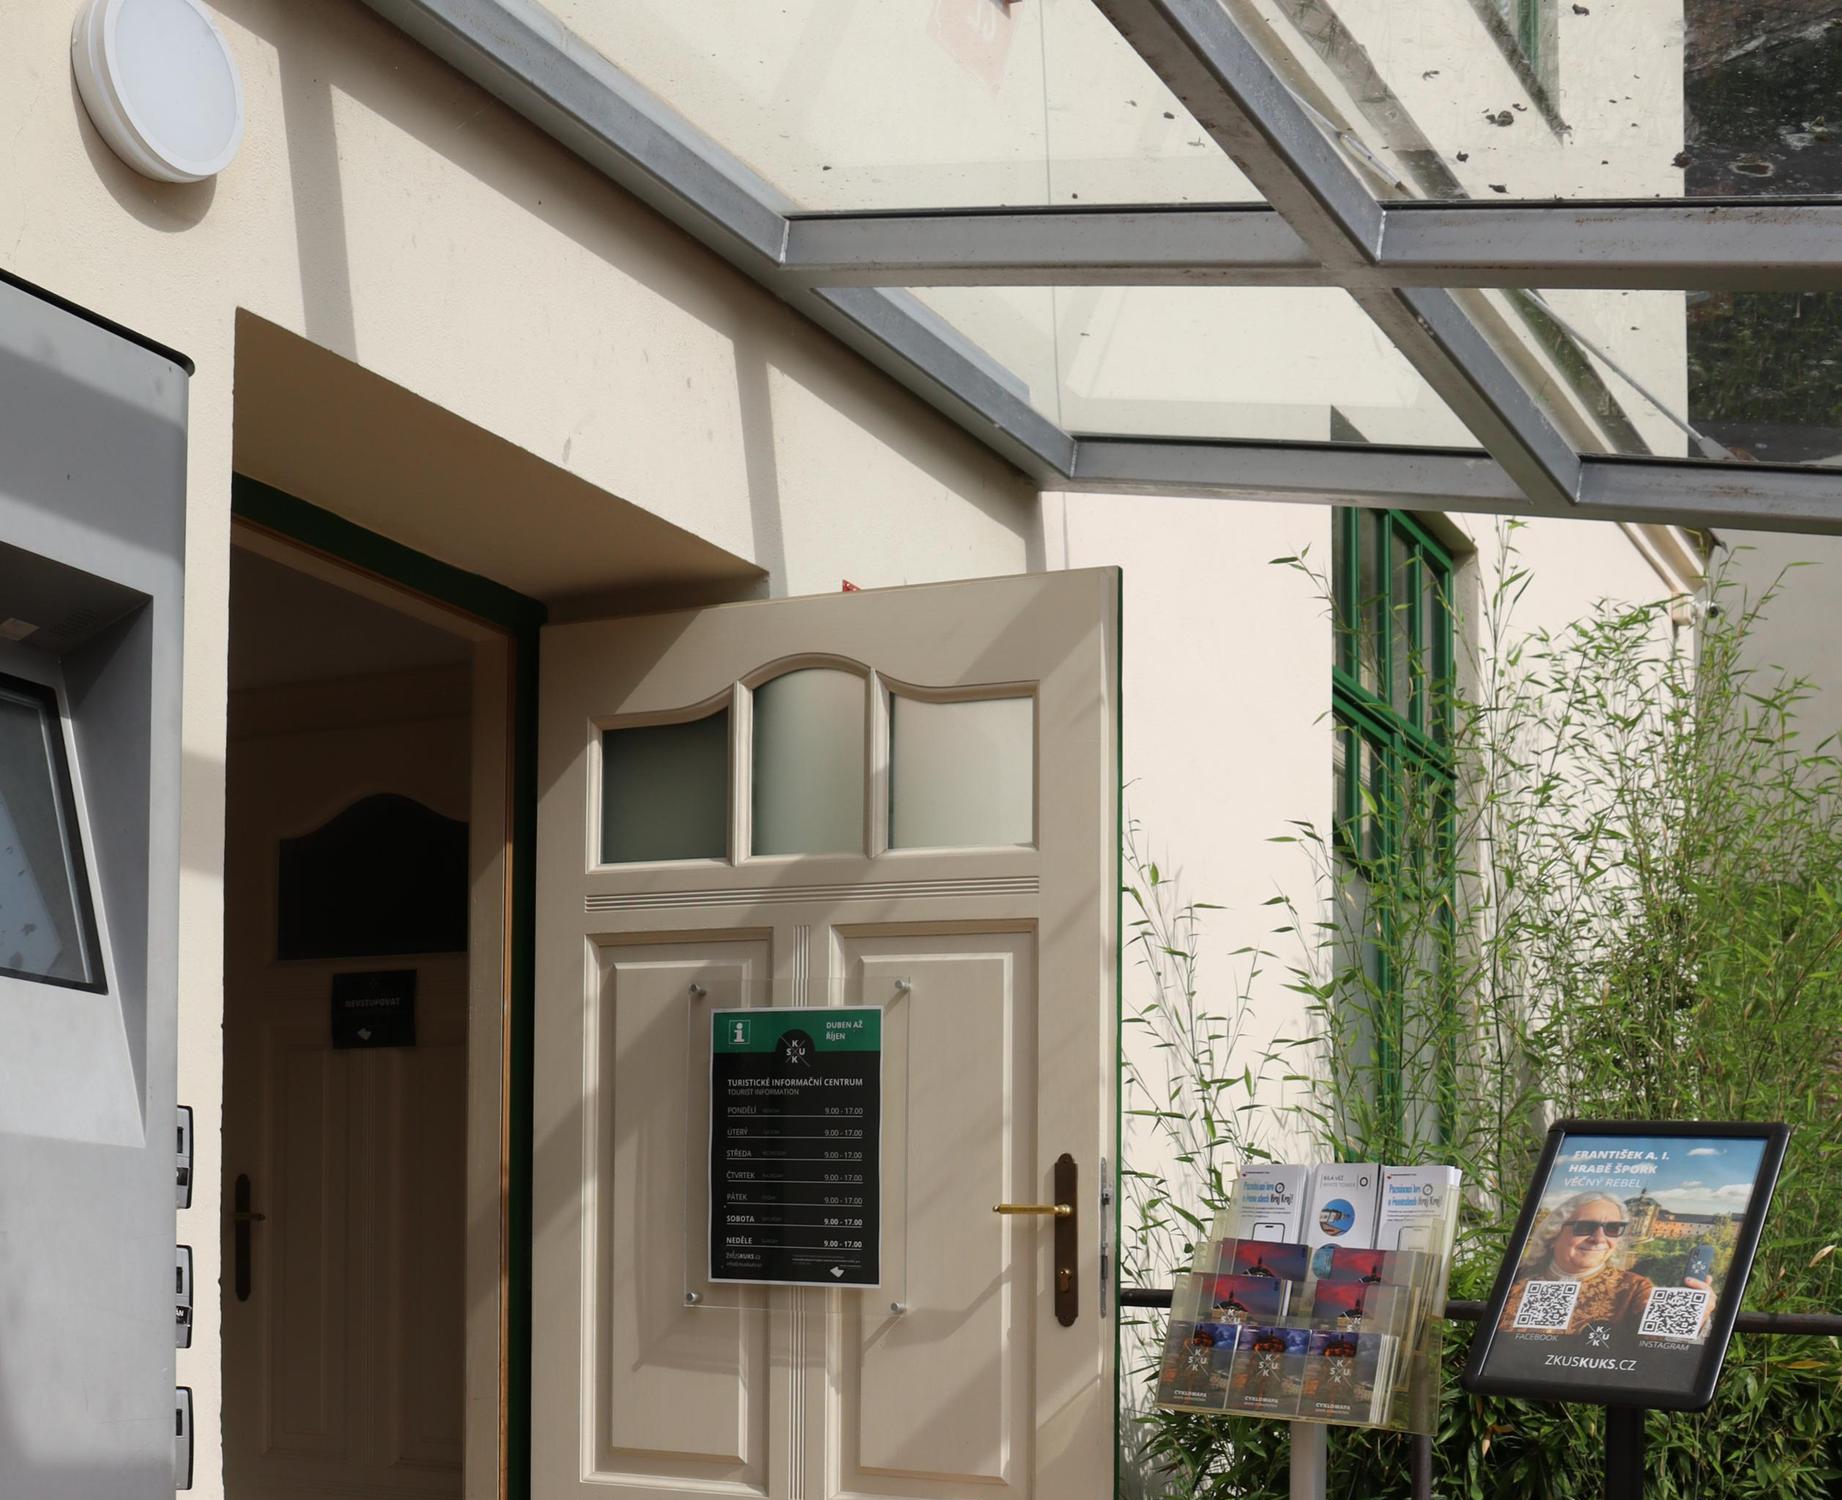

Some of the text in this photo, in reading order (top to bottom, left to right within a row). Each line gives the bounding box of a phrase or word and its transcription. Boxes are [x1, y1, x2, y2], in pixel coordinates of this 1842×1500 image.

[826, 1019, 864, 1029] DUBEN AŽ
[727, 1076, 864, 1087] TURISTICKÉ INFORMAČNÍ CENTRUM
[727, 1088, 799, 1096] TOURIST INFORMATION
[824, 1107, 839, 1115] 9.00
[844, 1107, 864, 1115] 17.00
[824, 1129, 839, 1137] 9.00
[844, 1129, 863, 1137] 17.00
[824, 1151, 839, 1160] 9.00
[844, 1151, 863, 1160] 17.00
[1574, 1148, 1644, 1160] FRANTIŠEK
[1644, 1151, 1658, 1160] A.
[1568, 1162, 1658, 1174] HRABĚ ŠPORK
[824, 1174, 839, 1182] 9.00
[844, 1174, 863, 1182] 17.00
[1605, 1178, 1642, 1188] REBEL
[824, 1196, 839, 1205] 9.00
[844, 1196, 863, 1205] 17.00
[726, 1215, 755, 1223] SOBOTA
[823, 1218, 839, 1227] 9.00
[844, 1218, 863, 1227] 17.00
[726, 1234, 753, 1245] NEDĚLE
[823, 1240, 839, 1248] 9.00
[844, 1240, 863, 1248] 17.00
[1514, 1333, 1559, 1343] FACEBOOK
[1638, 1340, 1690, 1352] INSTAGRAM
[1544, 1354, 1637, 1371] ZKUSKUKS.CZ
